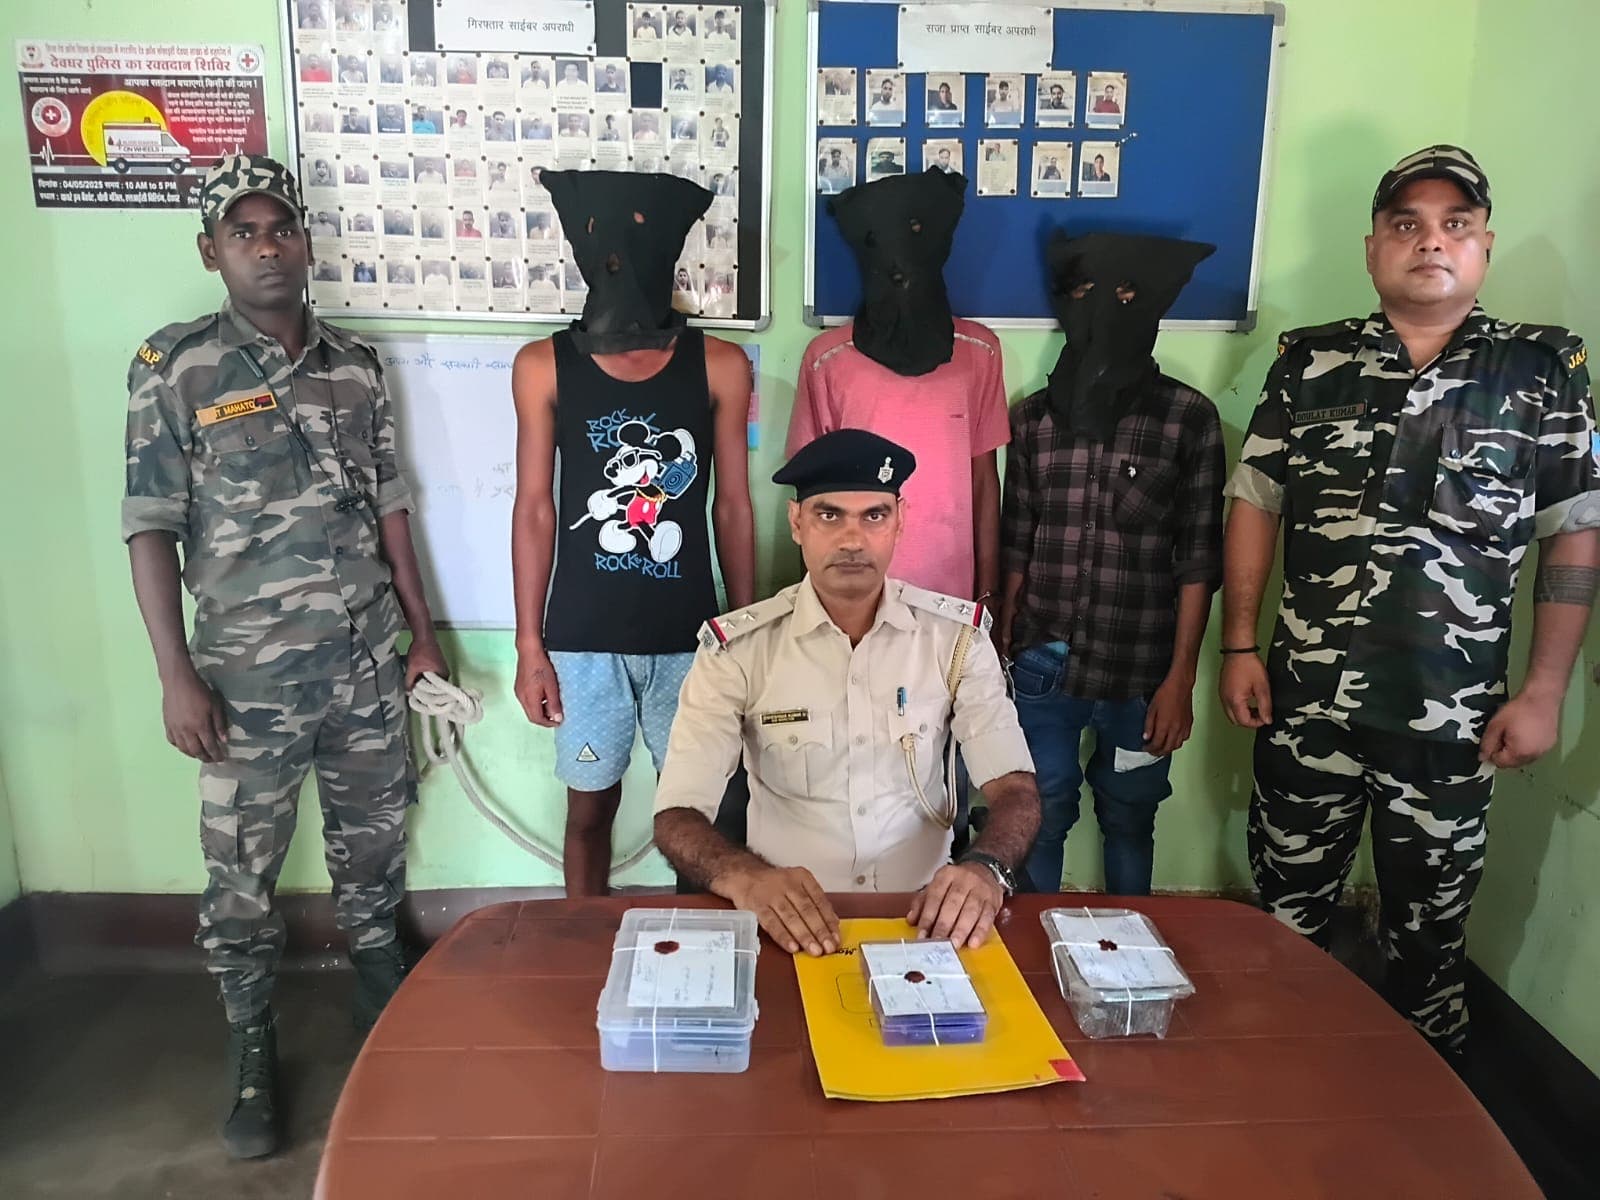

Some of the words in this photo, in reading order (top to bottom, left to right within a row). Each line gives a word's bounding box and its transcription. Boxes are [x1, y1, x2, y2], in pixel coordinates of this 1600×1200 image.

[542, 20, 575, 33] अपराधी
[926, 23, 946, 34] सजा
[950, 24, 970, 35] प्राप्त
[1005, 25, 1037, 37] अपराधी
[50, 53, 83, 69] देवघर
[86, 55, 121, 73] पुलिस
[125, 59, 142, 70] का
[195, 56, 231, 72] शिविर
[586, 408, 631, 432] ROCK
[594, 552, 638, 571] ROCK
[642, 560, 682, 579] ROLL
